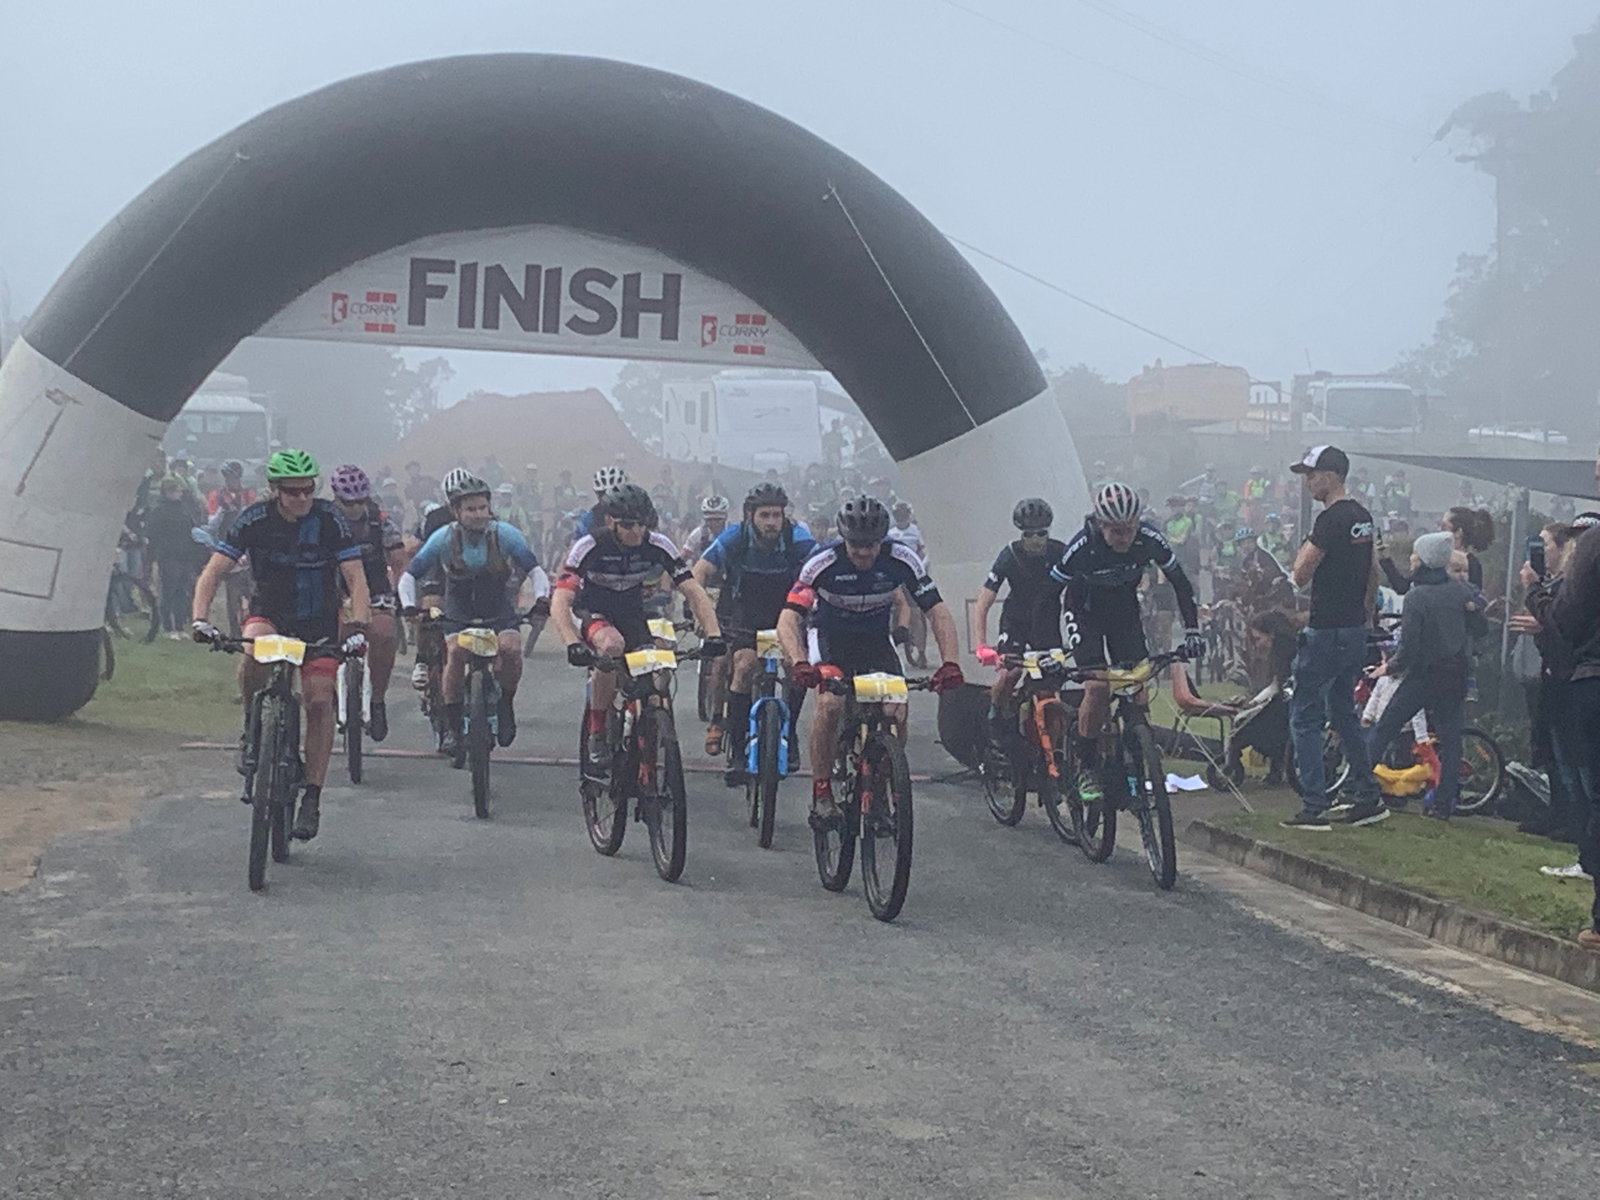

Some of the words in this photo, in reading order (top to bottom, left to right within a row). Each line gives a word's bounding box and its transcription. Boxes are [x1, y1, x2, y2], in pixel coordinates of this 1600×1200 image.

[407, 257, 682, 341] FINISH
[350, 302, 400, 316] CORRY
[719, 324, 770, 338] CORRY
